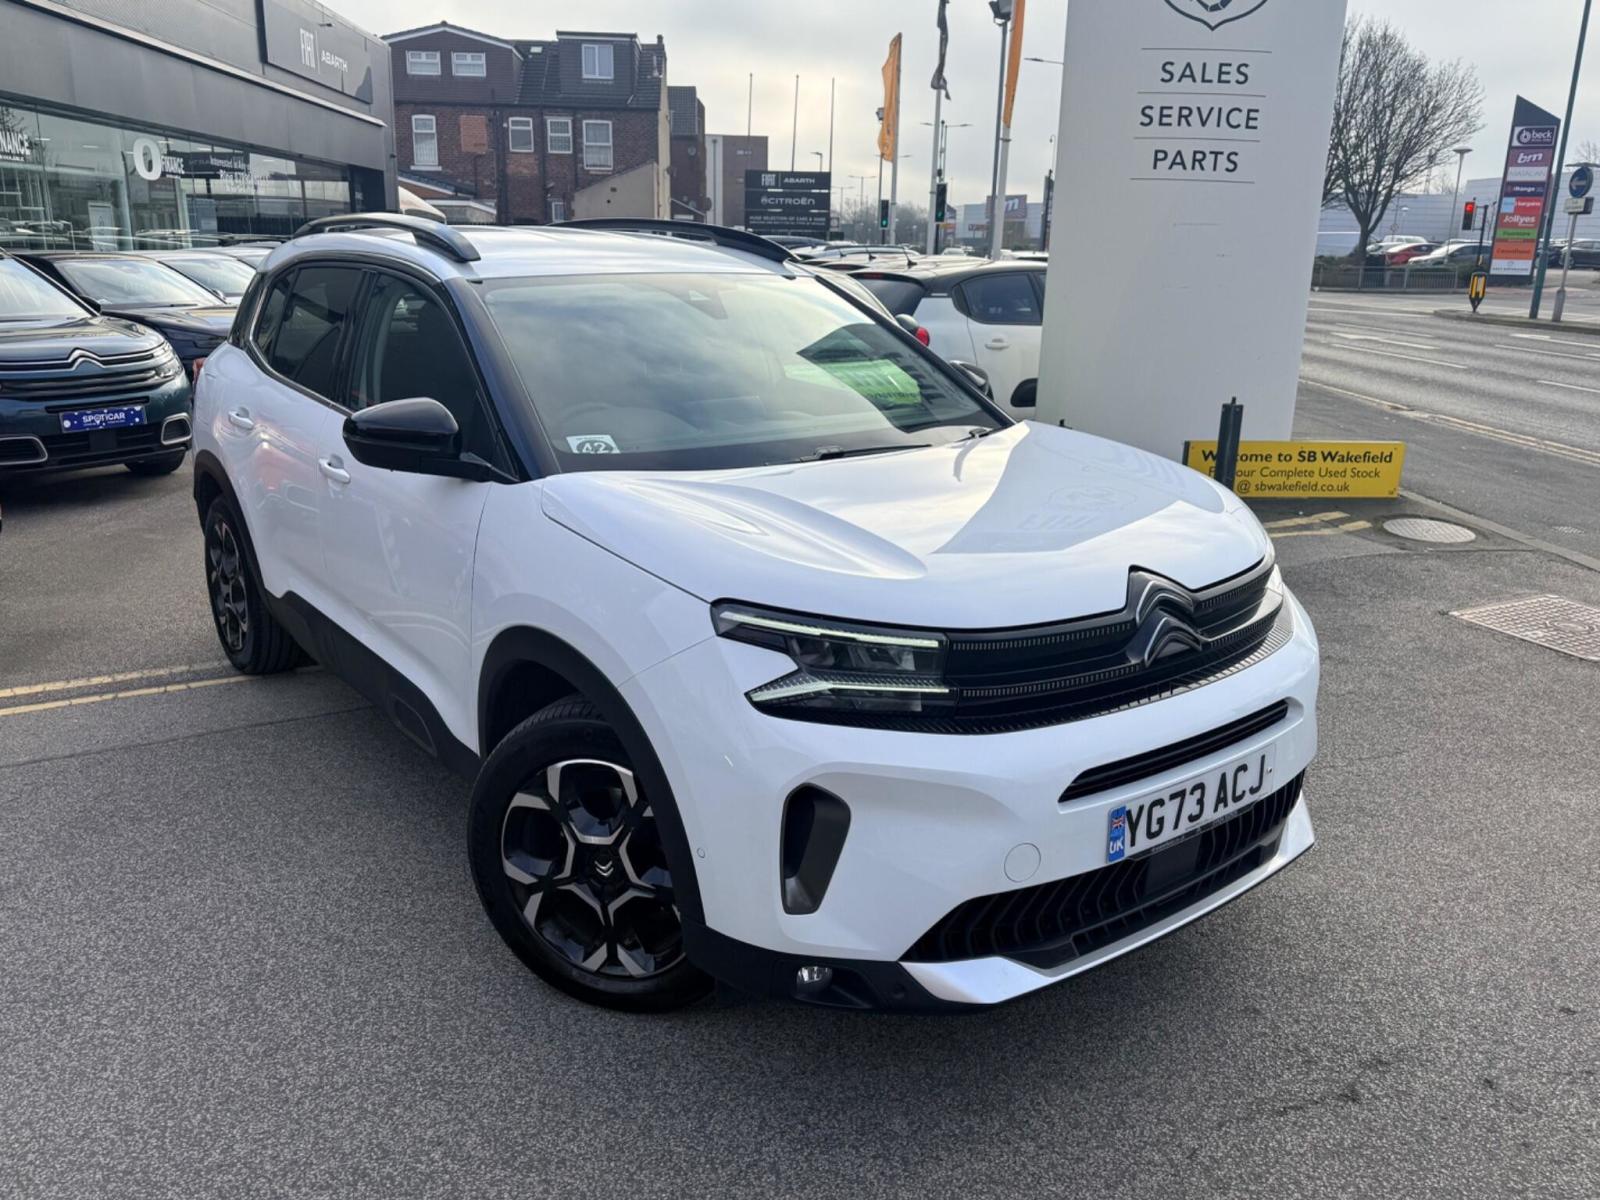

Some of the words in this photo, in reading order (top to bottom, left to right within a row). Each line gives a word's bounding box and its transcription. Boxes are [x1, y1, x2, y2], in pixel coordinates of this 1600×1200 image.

[321, 50, 348, 72] ABARTH
[1160, 61, 1250, 85] SALES
[1139, 105, 1260, 130] SERVICE
[1152, 149, 1239, 173] PARTS
[761, 174, 776, 186] FIAT
[1503, 214, 1536, 225] Jollyes
[82, 412, 126, 425] SPOTICAR
[1202, 449, 1272, 462] Wome
[1278, 452, 1293, 462] to
[1298, 450, 1317, 462] SB
[1321, 450, 1393, 463] Wakefield
[1260, 466, 1315, 480] Complete
[1319, 467, 1347, 478] Used
[1350, 467, 1381, 478] Stock
[1237, 480, 1251, 494] @
[1255, 480, 1350, 492] sbwakefield.co.uk
[1126, 782, 1206, 847] YG73
[1213, 754, 1266, 813] ACJ
[1109, 837, 1124, 854] UK
